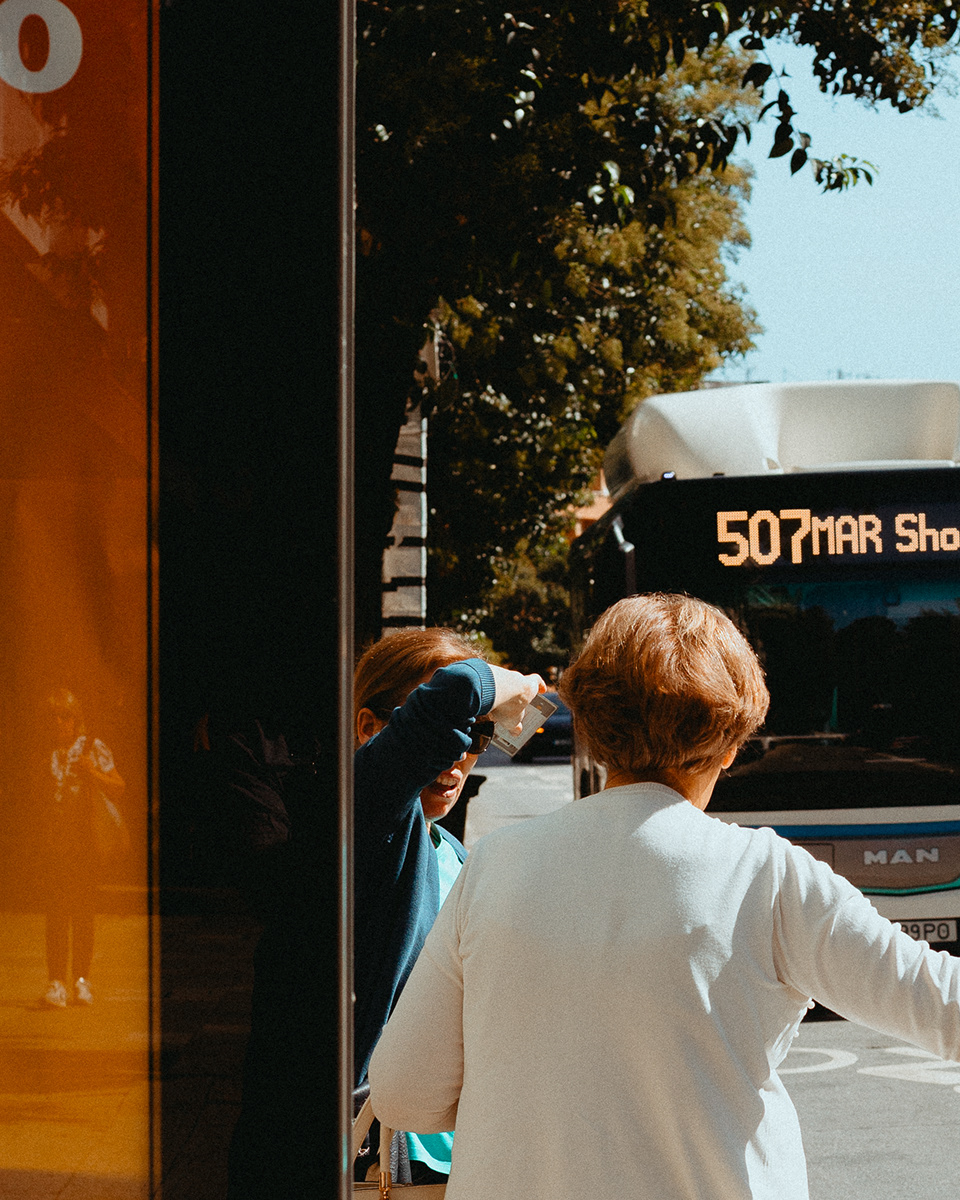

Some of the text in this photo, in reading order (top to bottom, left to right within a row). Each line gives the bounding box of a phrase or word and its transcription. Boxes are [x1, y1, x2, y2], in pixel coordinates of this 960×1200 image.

[716, 508, 812, 567] 507
[811, 514, 883, 556] MAR
[863, 847, 940, 866] MAN
